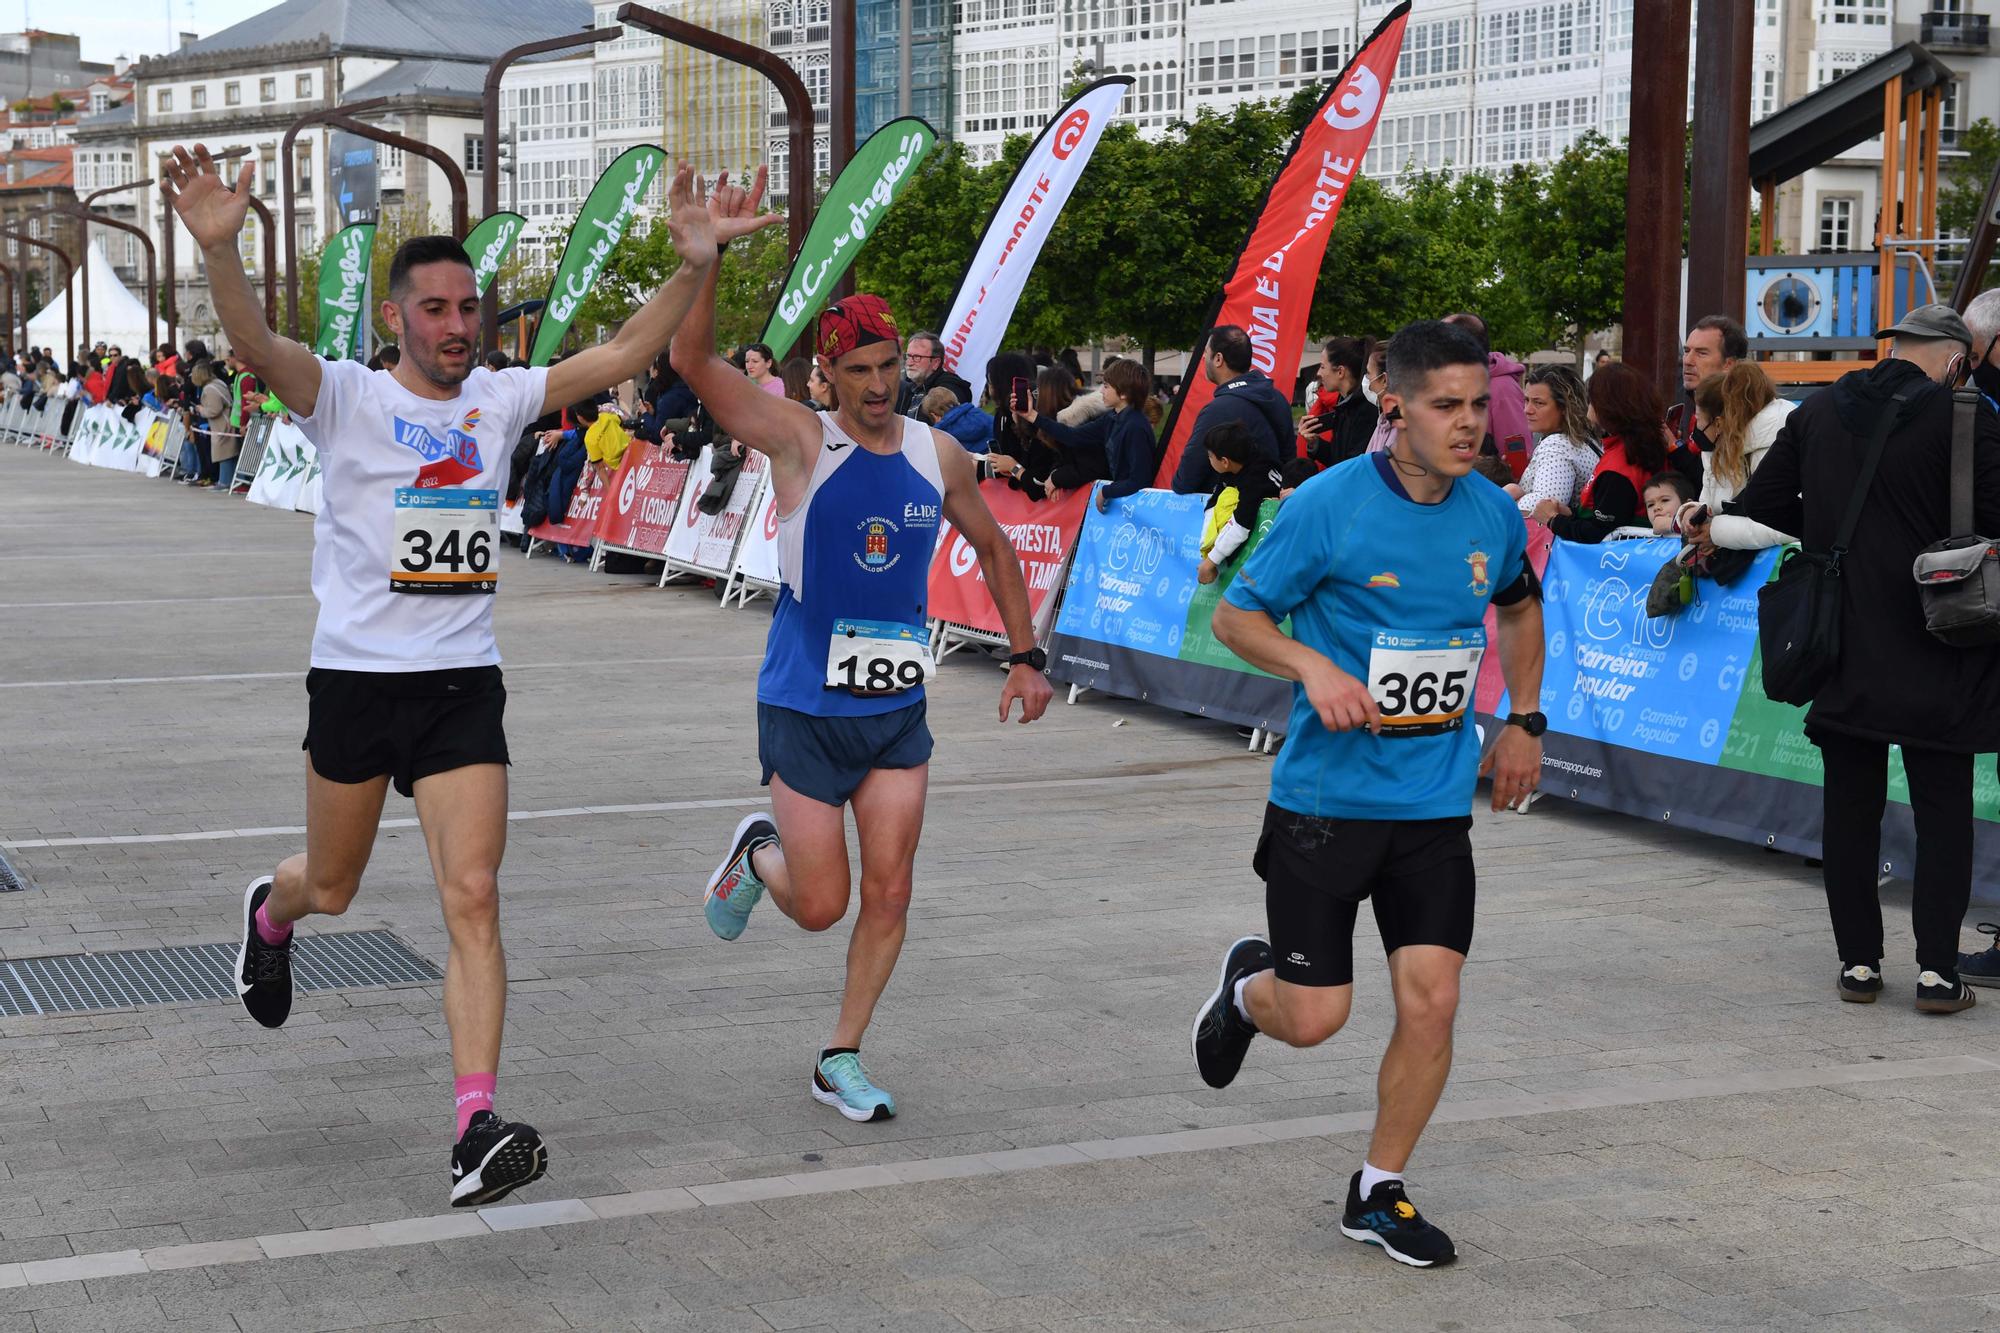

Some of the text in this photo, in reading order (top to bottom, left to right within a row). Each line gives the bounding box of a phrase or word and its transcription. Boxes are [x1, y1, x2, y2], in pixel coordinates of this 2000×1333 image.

[549, 294, 578, 323] El
[591, 153, 654, 245] Inglés
[777, 288, 808, 325] El
[849, 132, 923, 240] Inglés
[421, 476, 440, 489] 2022
[903, 502, 938, 518] ÉLIDE
[400, 529, 491, 573] 346
[838, 655, 925, 691] 189
[1575, 644, 1649, 680] Carreira
[1376, 670, 1468, 717] 365
[1573, 670, 1636, 702] Popular
[1631, 722, 1681, 745] Popular
[1639, 707, 1689, 729] Carreira
